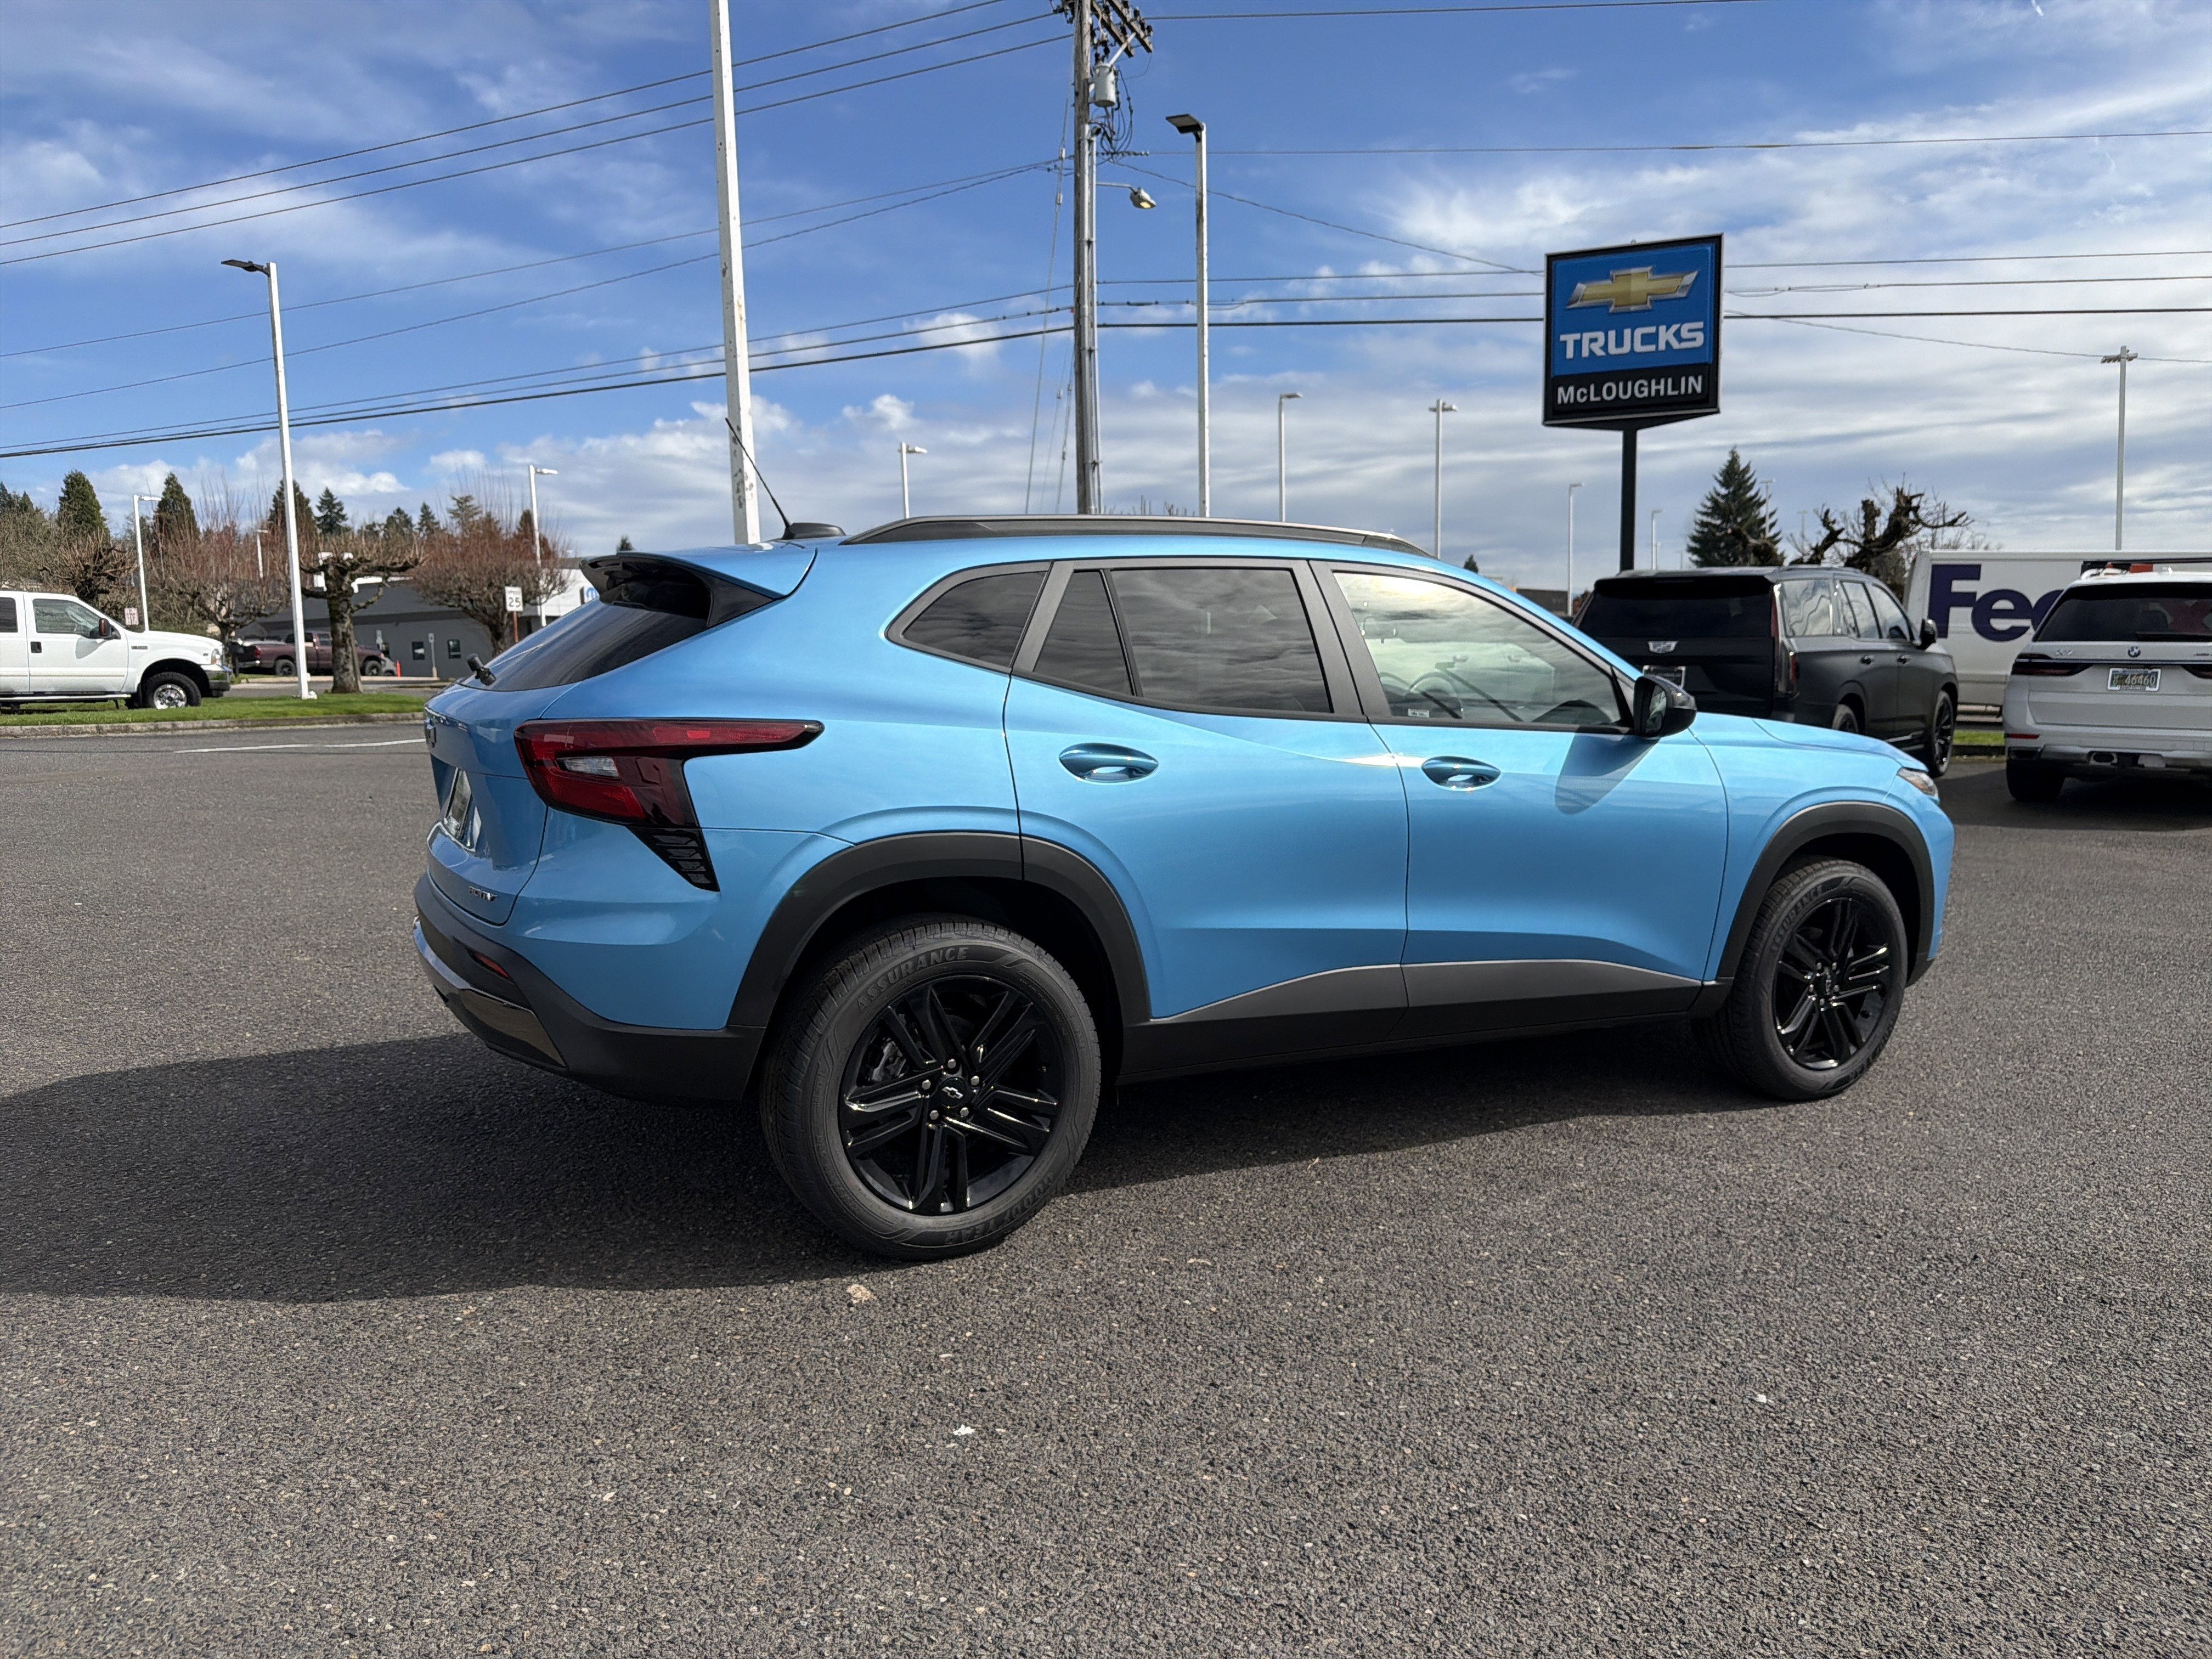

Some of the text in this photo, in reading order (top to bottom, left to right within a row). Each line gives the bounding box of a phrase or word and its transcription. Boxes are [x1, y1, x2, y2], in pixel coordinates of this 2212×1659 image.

[1559, 321, 1704, 359] TRUCKS
[1557, 375, 1702, 404] McLOUGHLIN
[508, 596, 521, 608] 25
[857, 946, 969, 1011] ASSURANCE
